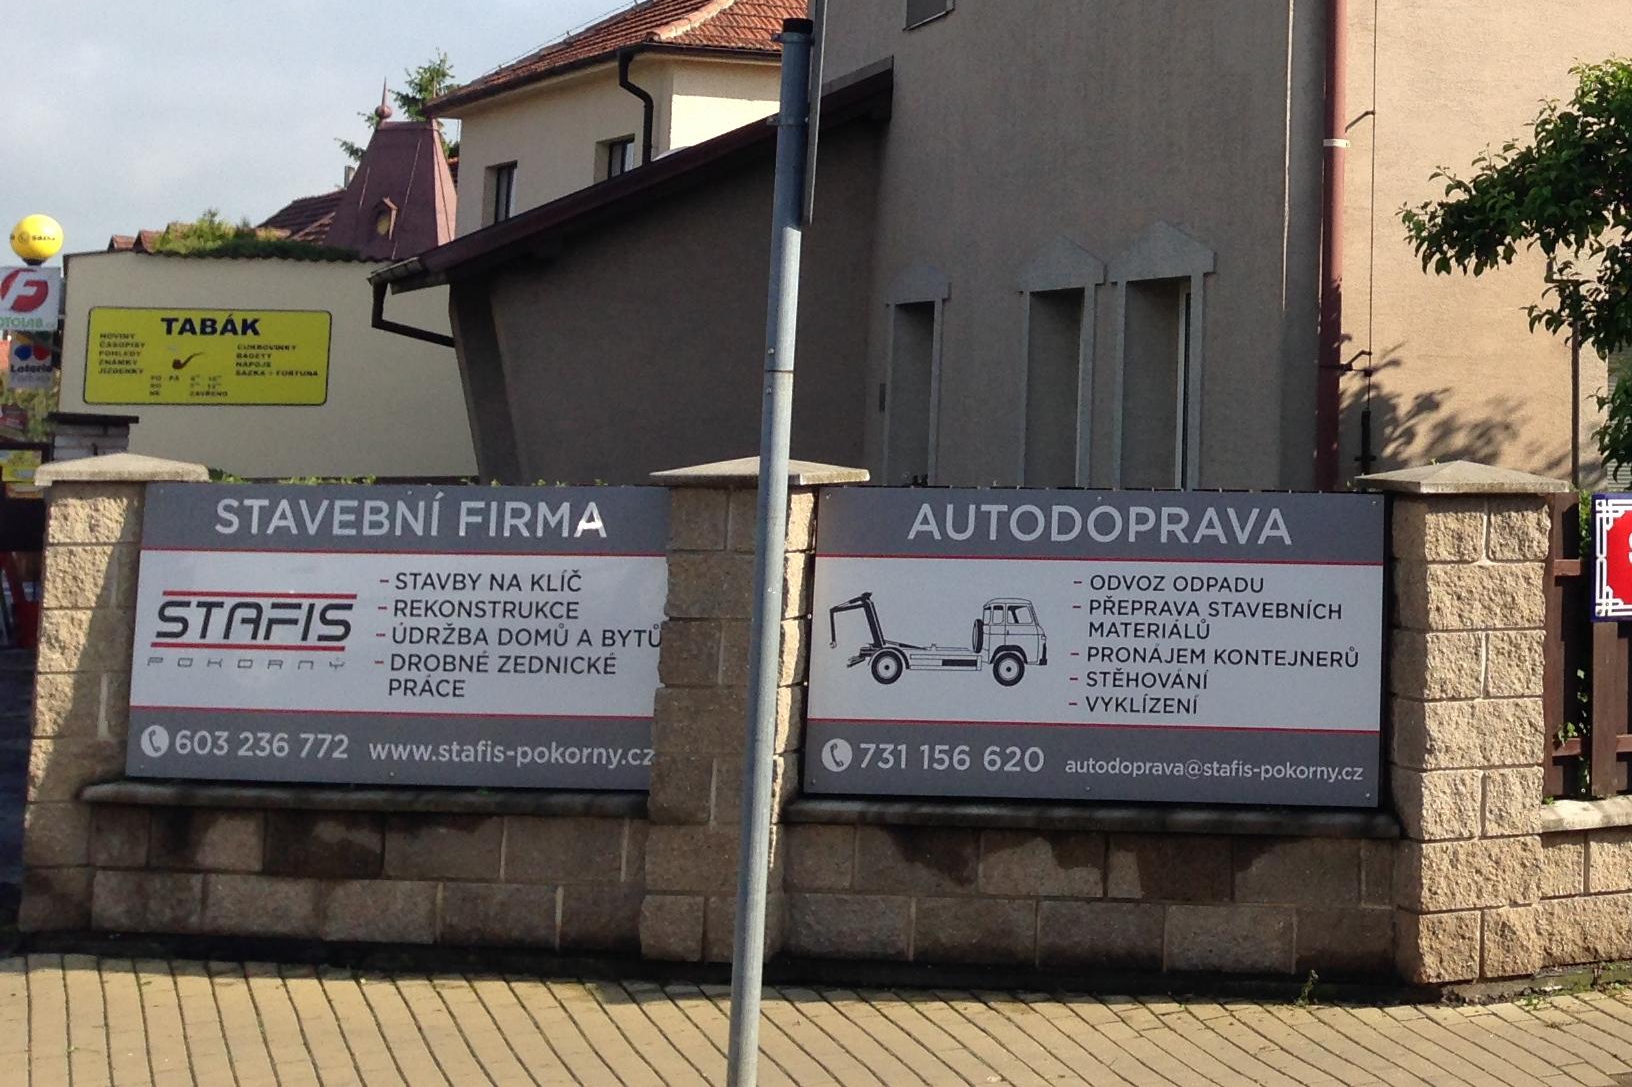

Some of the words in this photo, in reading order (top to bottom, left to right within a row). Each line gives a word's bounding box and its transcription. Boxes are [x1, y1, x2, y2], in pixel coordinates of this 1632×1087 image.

[161, 314, 260, 336] TABÁK
[215, 491, 444, 537] STAVEBNÍ
[459, 501, 607, 539] FIRMA
[907, 503, 1292, 545] AUTODOPRAVA
[395, 572, 481, 591] STAVBY
[489, 573, 522, 591] NA
[531, 570, 582, 593] KLÍČ
[1090, 574, 1166, 592] ODVOZ
[1174, 575, 1264, 593] ODPADU
[394, 600, 580, 619] REKONSTRUKCE
[1089, 595, 1199, 616] PŘEPRAVA
[1208, 600, 1343, 619] STAVEBNÍCH
[155, 600, 353, 643] STAFIS
[1089, 618, 1211, 640] MATERIÁLŮ
[393, 623, 490, 646] ÚDRŽBA
[498, 622, 569, 646] DOMŮ
[576, 627, 593, 647] A
[601, 622, 663, 648] BYTŮ
[390, 650, 489, 673] DROBNÉ
[497, 653, 617, 675] ZEDNICKÉ
[1087, 642, 1207, 664] PRONÁJEM
[1214, 646, 1359, 669] KONTEJNERŮ
[388, 676, 466, 698] PRÁCE
[1086, 667, 1209, 690] STĚHOVÁNÍ
[1085, 692, 1199, 715] VYKLÍZENÍ
[175, 730, 228, 756] 603
[238, 732, 289, 757] 236
[301, 734, 349, 758] 772
[369, 738, 655, 768] www.stafis-pokorny.cz
[860, 743, 908, 769] 731
[920, 745, 970, 771] 156
[984, 746, 1045, 772] 620
[1065, 757, 1363, 782] autodoprava@stafis-pokorny.cz
